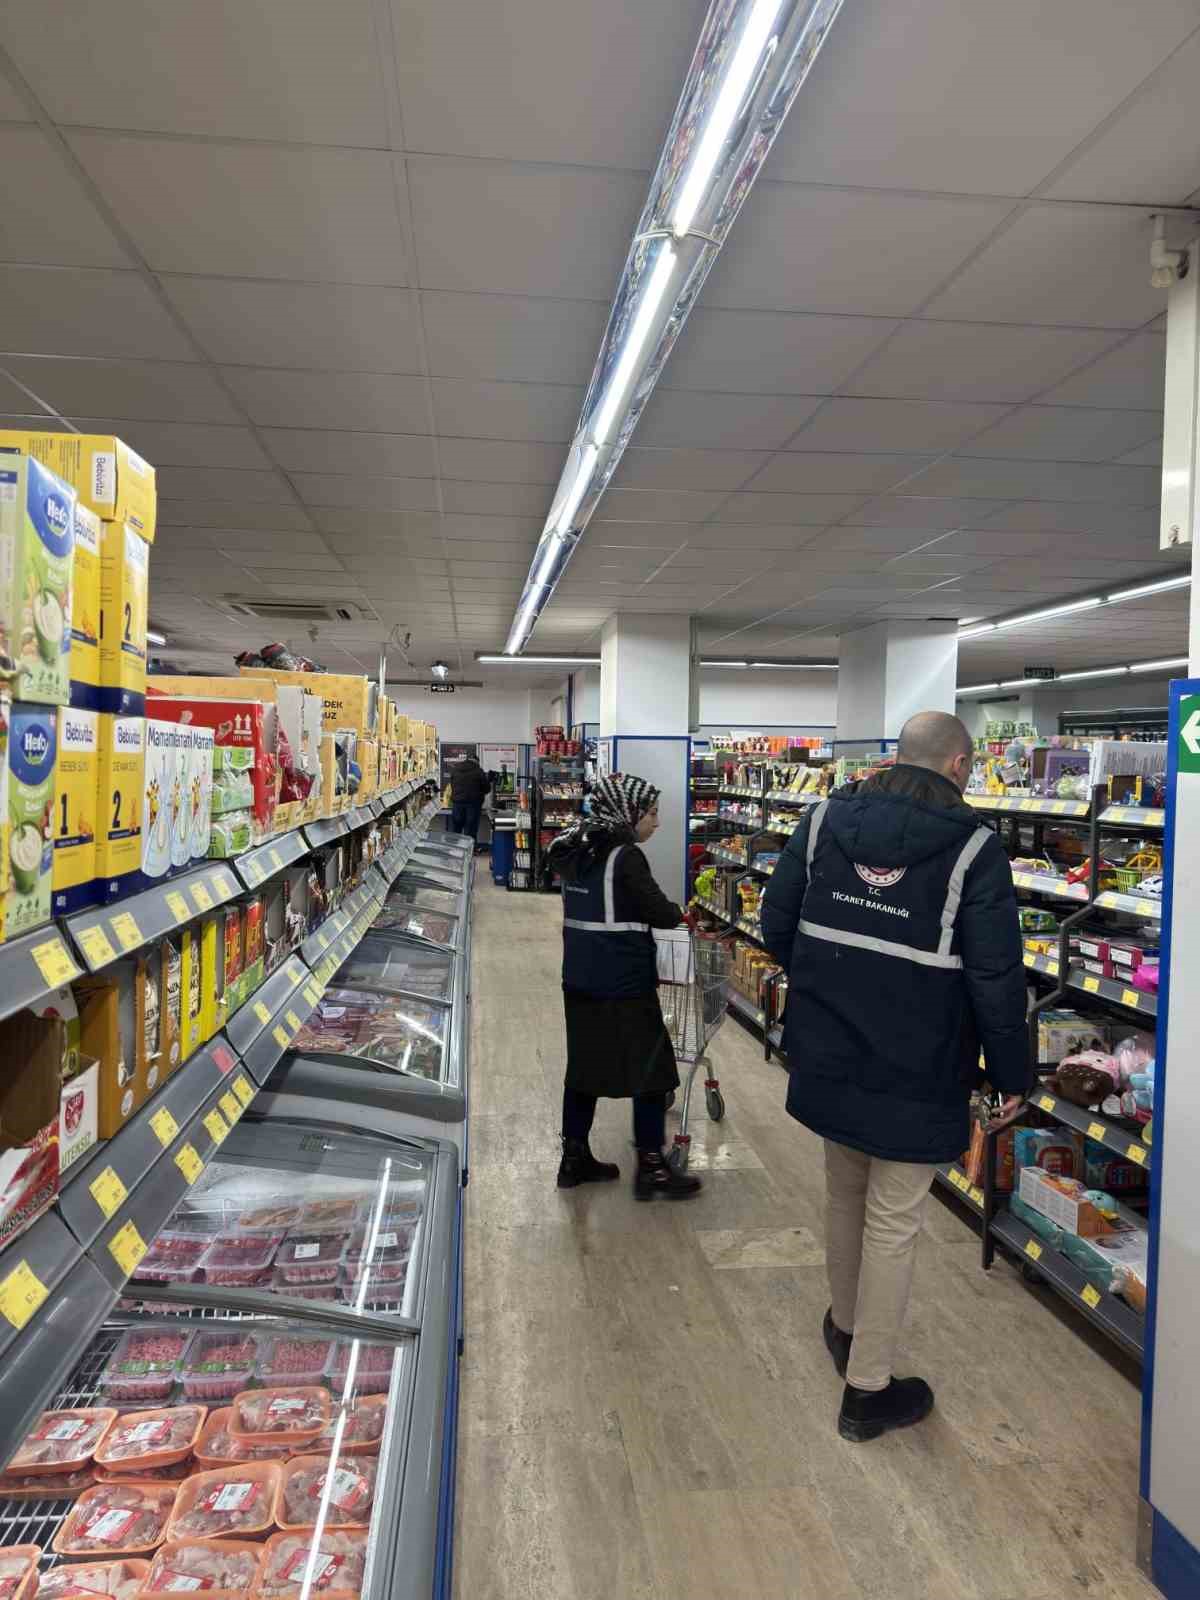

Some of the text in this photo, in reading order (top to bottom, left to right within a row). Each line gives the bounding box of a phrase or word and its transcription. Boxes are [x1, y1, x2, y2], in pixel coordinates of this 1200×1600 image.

[95, 456, 106, 496] Bebivita
[65, 721, 93, 743] Bebivita
[60, 793, 68, 835] 1
[112, 790, 121, 828] 2
[832, 891, 909, 918] TİCARET BAKANLIĞI
